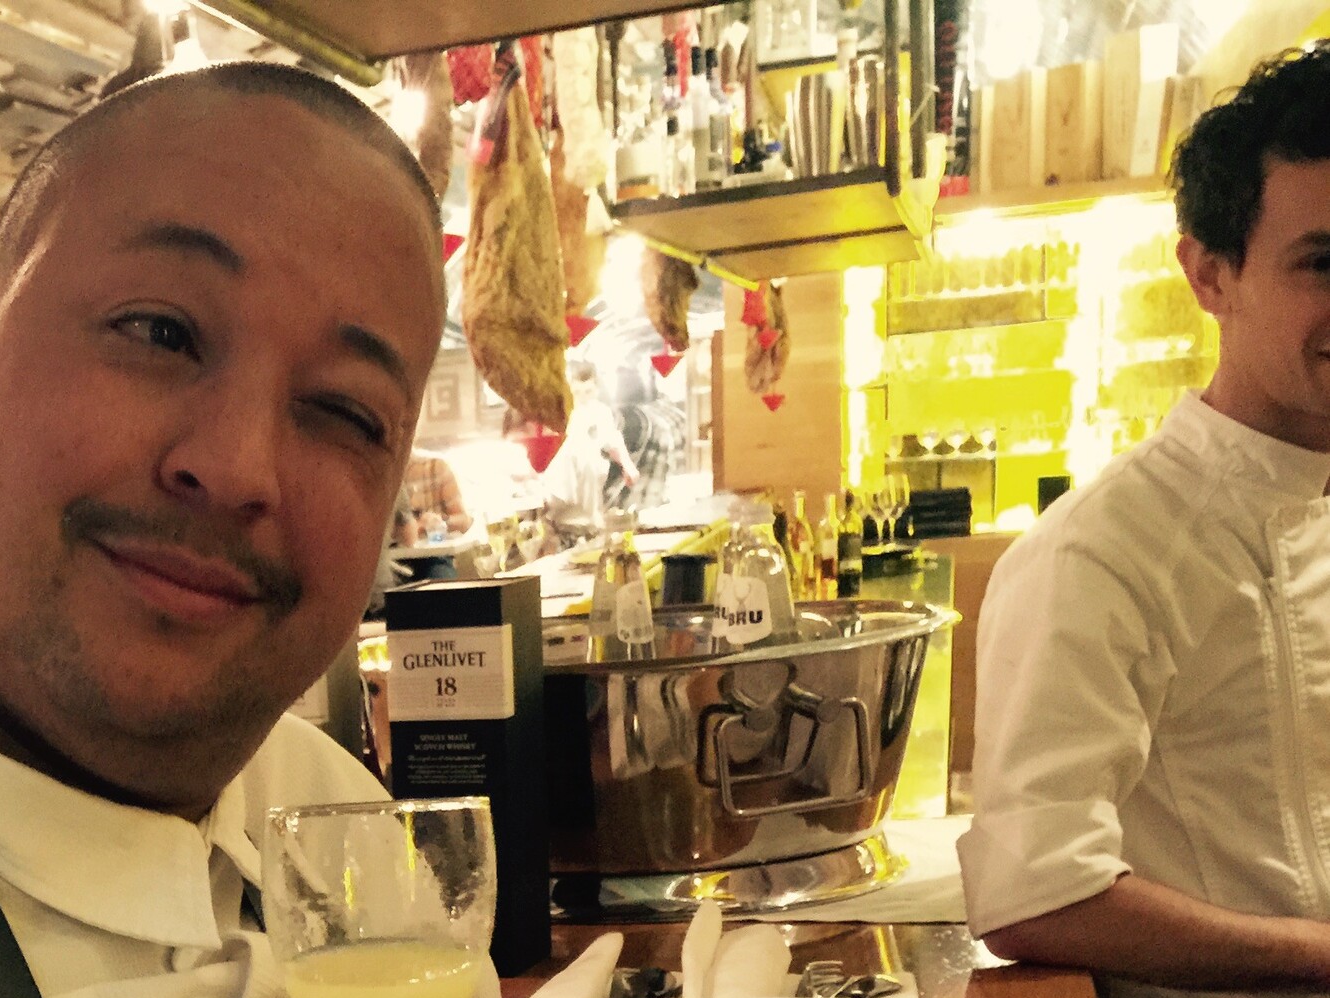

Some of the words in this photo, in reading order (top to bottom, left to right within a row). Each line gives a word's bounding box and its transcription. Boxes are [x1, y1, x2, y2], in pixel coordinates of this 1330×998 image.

[431, 640, 456, 652] THE
[403, 651, 487, 671] GLENLIVET
[435, 676, 458, 697] 18
